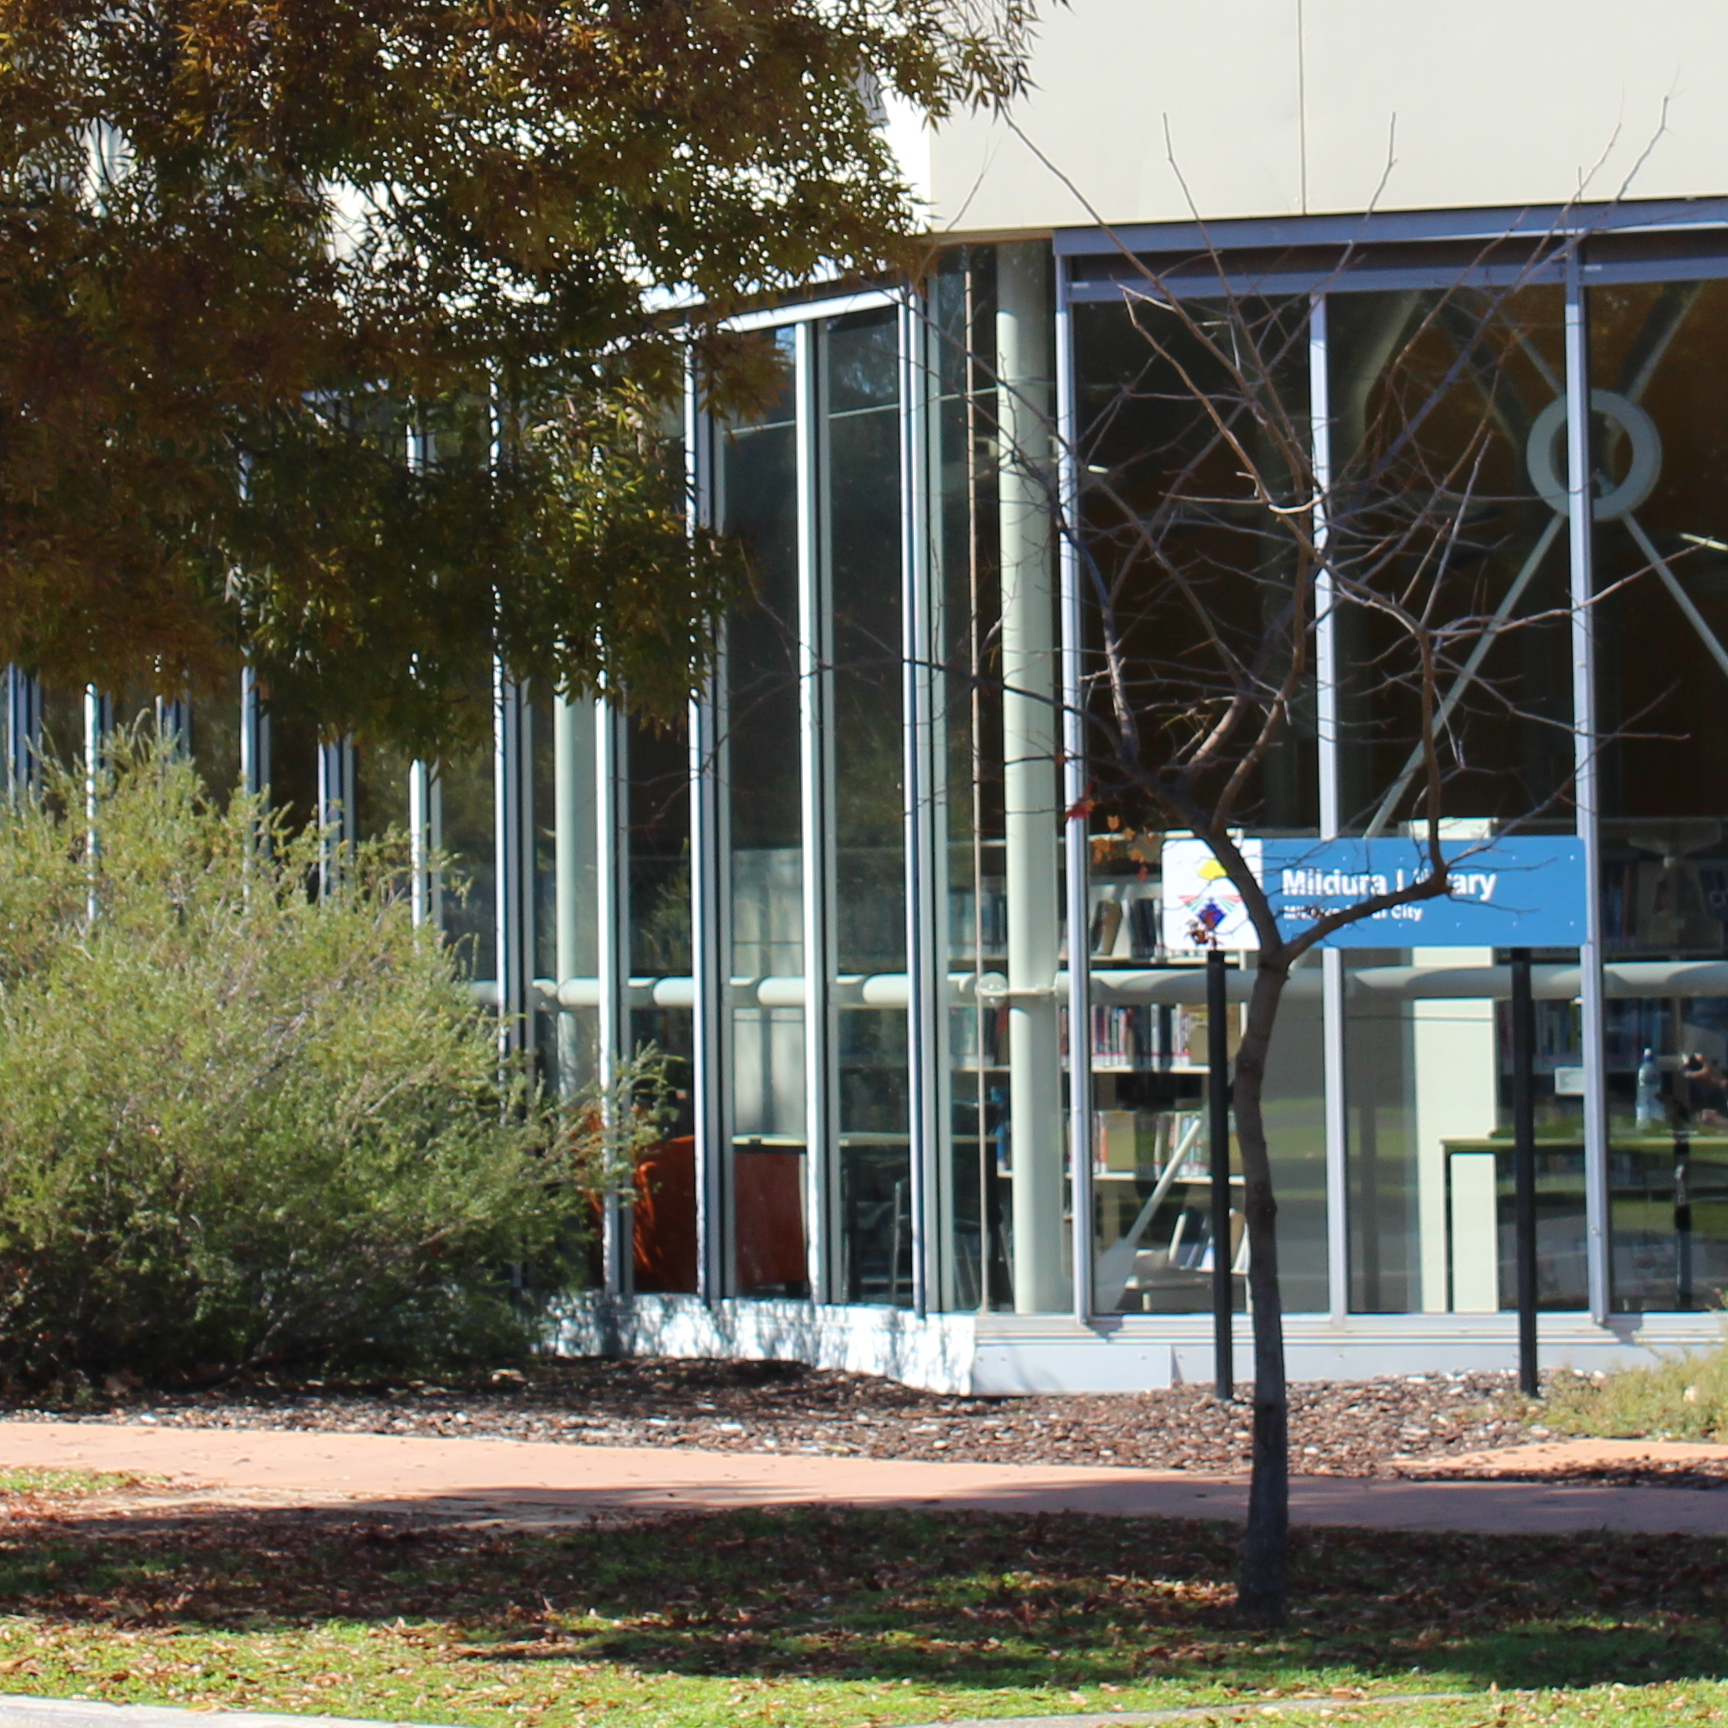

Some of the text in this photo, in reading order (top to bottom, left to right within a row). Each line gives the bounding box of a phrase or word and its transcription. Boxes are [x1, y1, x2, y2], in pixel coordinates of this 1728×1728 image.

[1282, 868, 1497, 902] Mildura Liary
[1391, 904, 1423, 922] City
